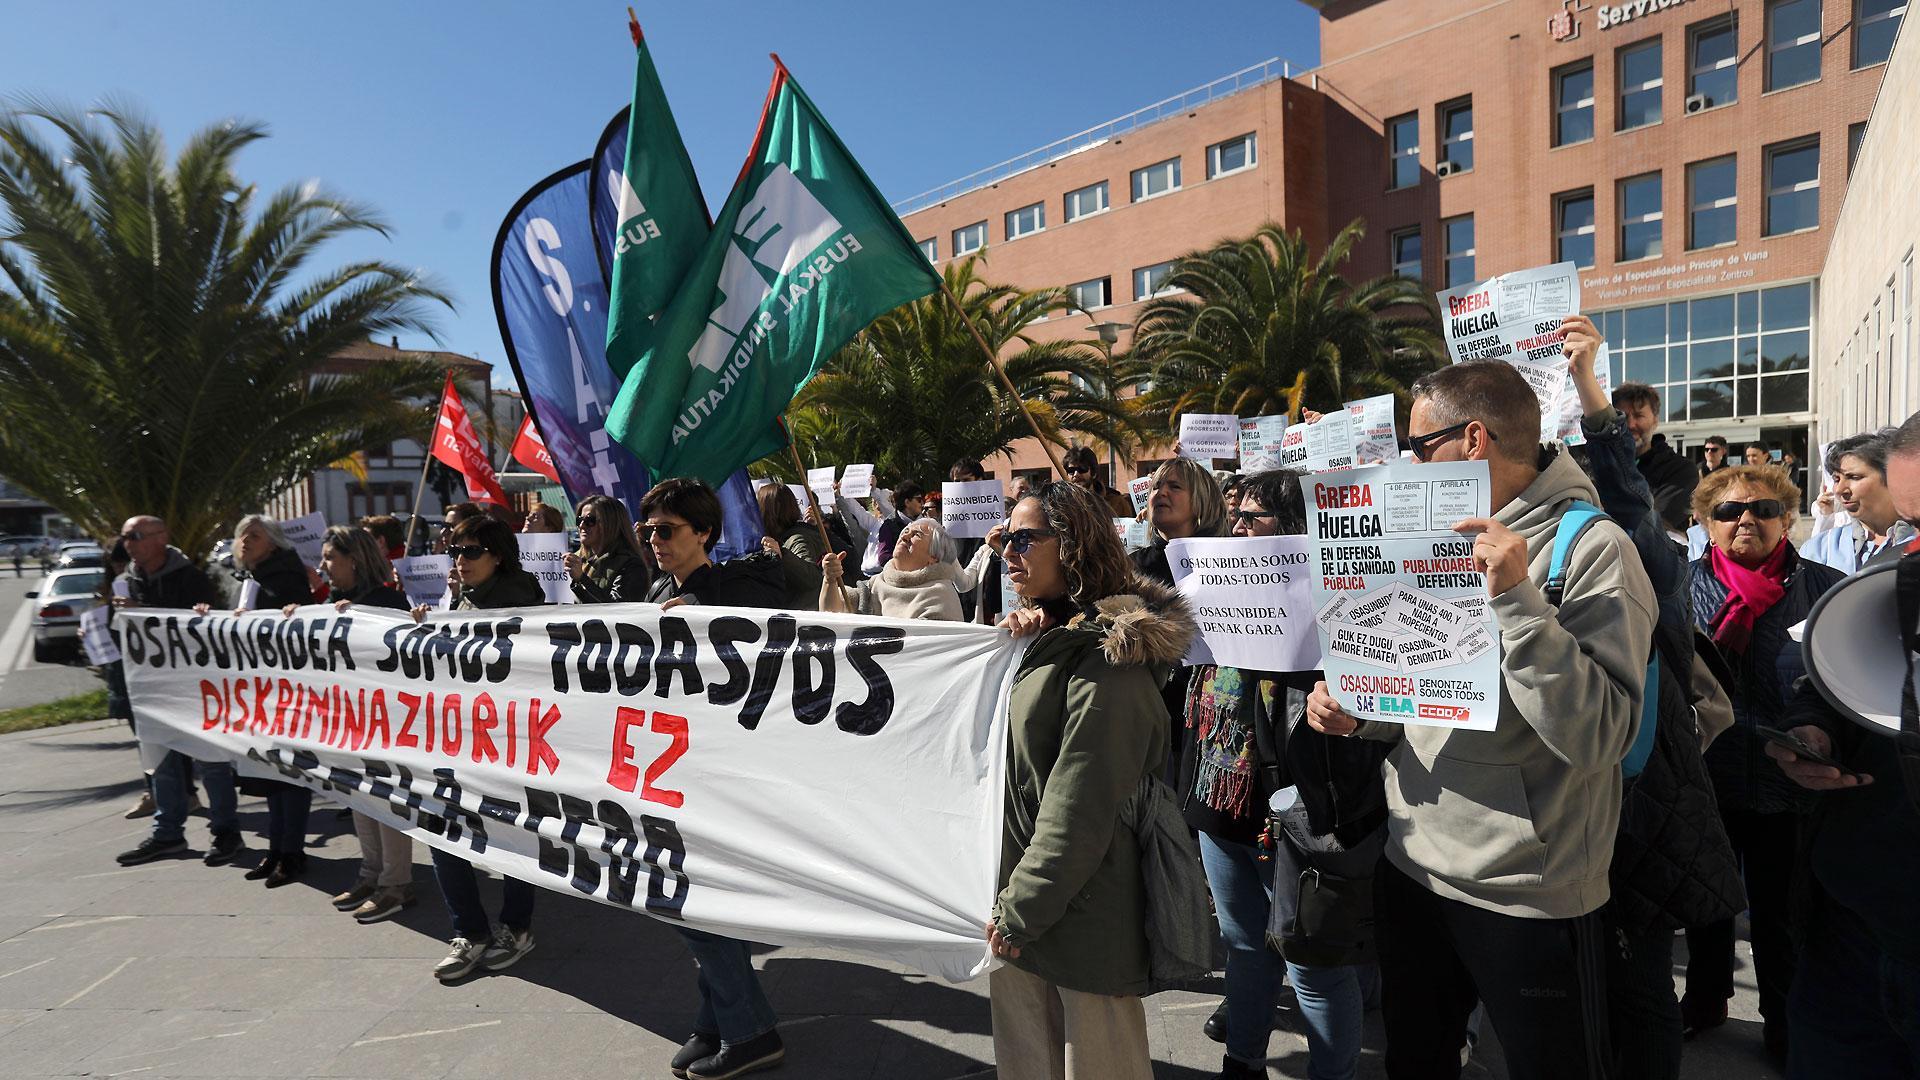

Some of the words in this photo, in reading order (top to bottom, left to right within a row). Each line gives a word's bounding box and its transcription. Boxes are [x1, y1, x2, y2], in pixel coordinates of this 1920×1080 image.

[1583, 278, 1610, 289] Centro
[1612, 275, 1622, 284] de
[1728, 254, 1739, 265] de
[1743, 250, 1769, 262] Viana
[1448, 291, 1490, 317] GREBA
[1451, 311, 1500, 339] HUELGA
[1534, 319, 1564, 335] OSASU
[1457, 343, 1468, 354] EN
[1467, 335, 1501, 352] DEFENSA
[1527, 343, 1564, 361] DEFENTS
[1282, 447, 1308, 466] HUELGA
[1328, 456, 1352, 467] OSASUN
[1315, 482, 1373, 511] GREBA
[972, 511, 1001, 520] TODXS
[1318, 512, 1383, 539] HUELGA
[518, 551, 563, 561] ASUNBIDEA
[1321, 547, 1334, 561] EN
[1336, 545, 1382, 560] DEFENSA
[1180, 556, 1259, 569] OSASUNBIDEA
[1322, 562, 1335, 575] DE
[1337, 561, 1350, 575] LA
[1351, 560, 1396, 575] SANIDAD
[541, 571, 569, 581] TODXS
[1199, 571, 1291, 586] TODAS-TODOS
[1416, 573, 1482, 589] DEFENTSAN
[1199, 606, 1287, 619] OSASUNBIDEA
[1397, 590, 1418, 606] PARA
[1417, 598, 1439, 615] UNAS
[1454, 615, 1462, 625] Y
[1355, 613, 1383, 628] OMOS
[1411, 607, 1431, 624] NADA
[1431, 617, 1438, 628] A
[1202, 621, 1243, 635] DENAK
[1245, 623, 1284, 635] GARA
[1397, 612, 1449, 644] TROPECIENTOS
[1337, 629, 1355, 642] GUK
[1357, 632, 1367, 645] EZ
[1369, 635, 1393, 650] DUGU
[126, 615, 356, 672] OSASUNBIDEA
[376, 616, 523, 684] SOMOS
[1331, 640, 1361, 656] AMORE
[1363, 646, 1398, 665] EMATEN
[1340, 674, 1416, 696] OSASUNBIDEA
[1419, 678, 1474, 691] DENONTZAT
[1420, 688, 1453, 699] SOMOS
[1454, 690, 1485, 701] TODXS
[1379, 696, 1415, 714] ELA
[200, 675, 562, 776] DISKRIMINAZIORIK
[606, 706, 691, 808] EZ
